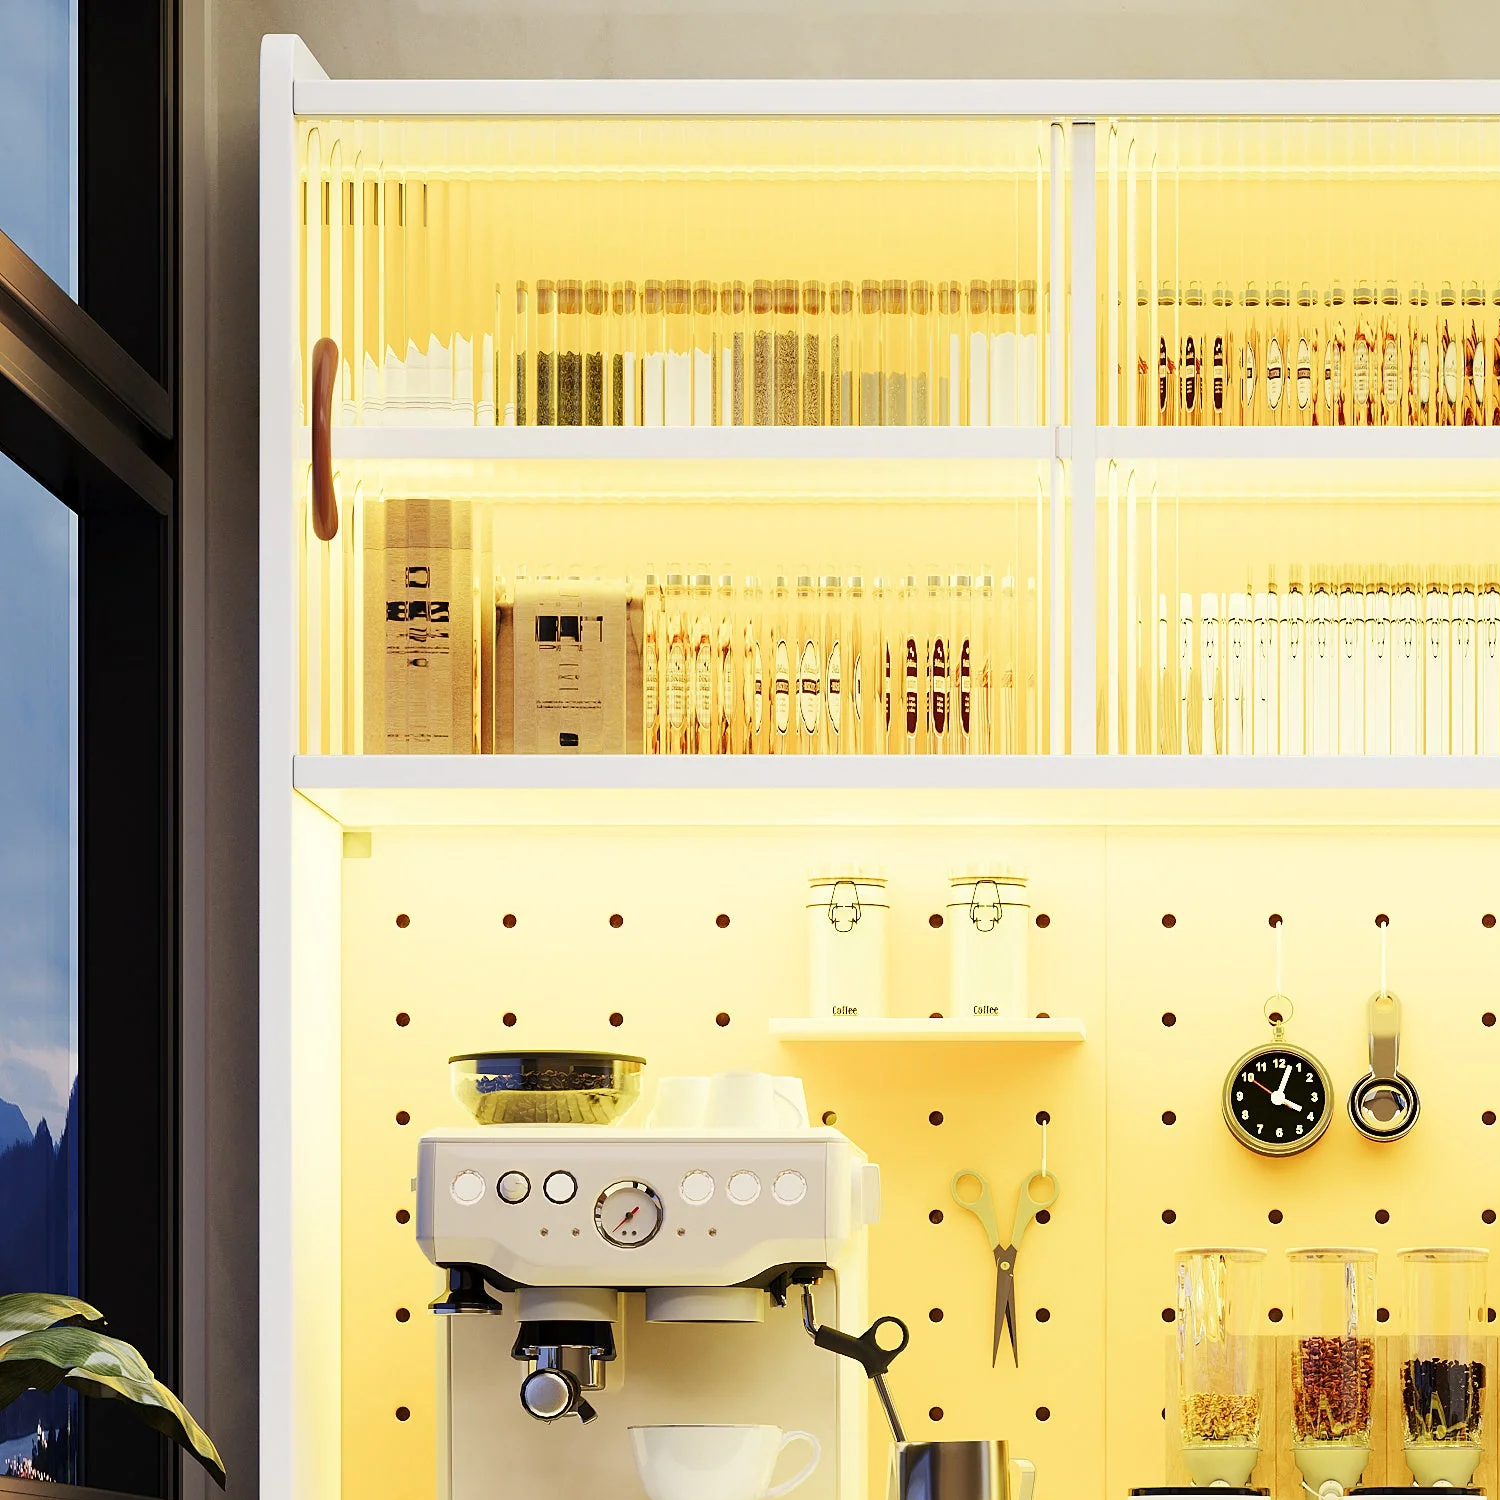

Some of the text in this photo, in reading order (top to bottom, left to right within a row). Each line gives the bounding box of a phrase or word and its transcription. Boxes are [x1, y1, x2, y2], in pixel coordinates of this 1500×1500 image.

[832, 1006, 858, 1016] Coffee
[973, 1005, 999, 1015] Coffee
[1256, 1062, 1267, 1072] 11
[1273, 1058, 1286, 1069] 12
[1296, 1063, 1302, 1072] 1
[1242, 1072, 1255, 1083] 10
[1306, 1072, 1314, 1083] 2
[1236, 1091, 1244, 1102] 9
[1311, 1092, 1319, 1103] 3
[1242, 1110, 1249, 1120] 8
[1307, 1112, 1315, 1121] 4
[1257, 1124, 1264, 1134] 7
[1276, 1128, 1284, 1138] 6
[1296, 1125, 1304, 1135] 5
